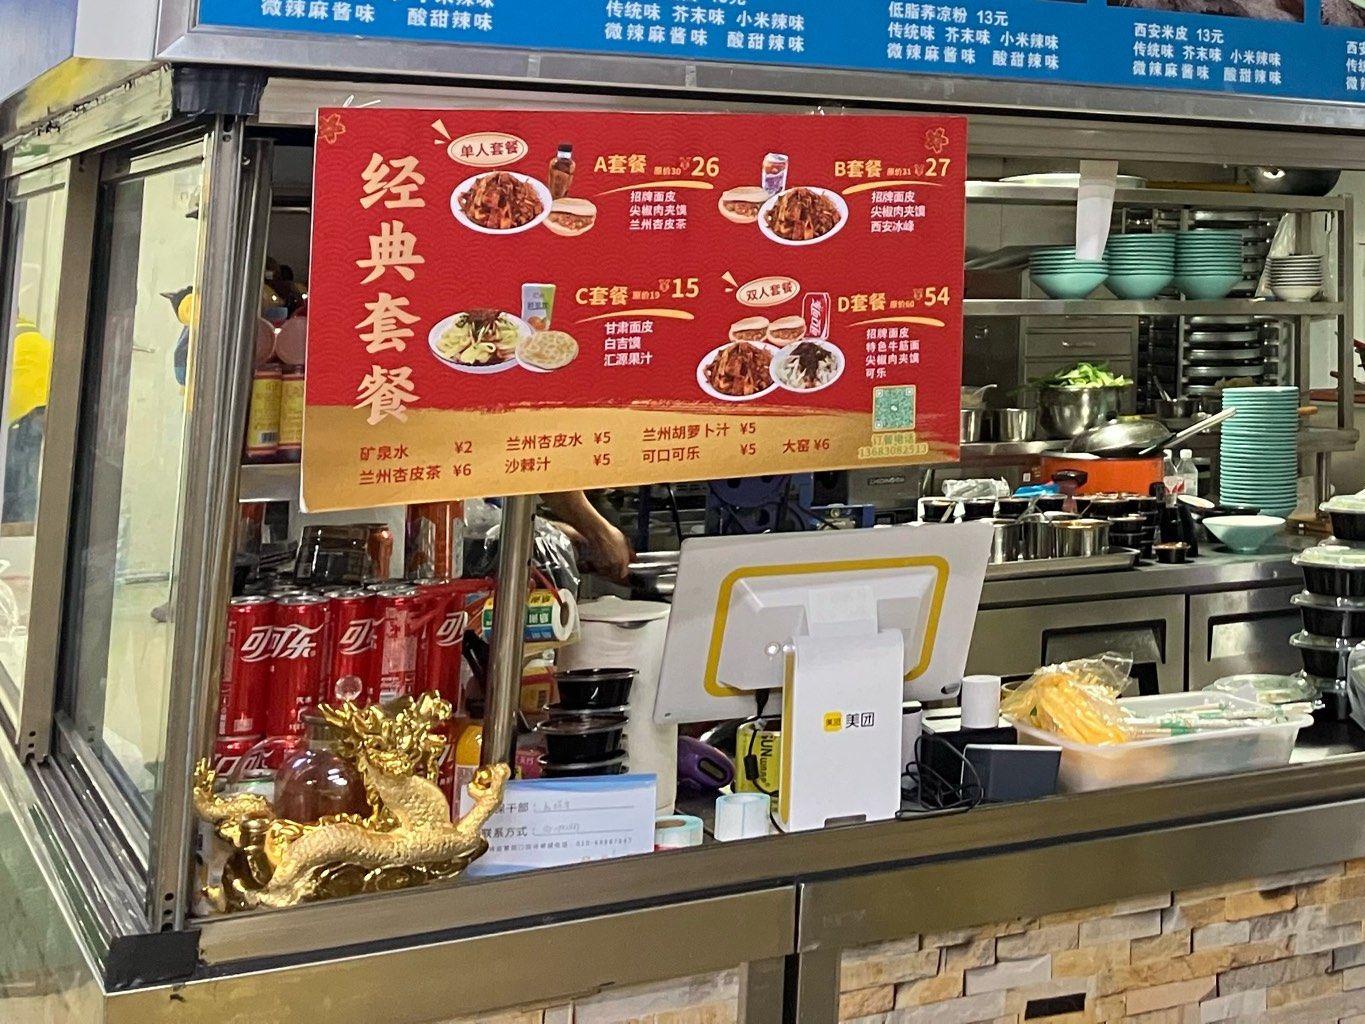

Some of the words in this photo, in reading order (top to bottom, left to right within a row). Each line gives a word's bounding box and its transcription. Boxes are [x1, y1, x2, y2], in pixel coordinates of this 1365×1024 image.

[407, 7, 493, 31] 酸甜辣味
[606, 0, 661, 20] 传统味
[672, 5, 725, 25] 芥末味
[736, 11, 805, 31] 小米辣味
[889, 1, 967, 23] 低脂荞凉粉
[977, 10, 1009, 26] 13元
[605, 23, 708, 46] 微辣麻酱味
[727, 31, 805, 53] 酸甜辣味
[888, 22, 935, 41] 传统味
[945, 27, 991, 45] 芥末味
[1000, 31, 1059, 50] 小米辣味
[1134, 22, 1188, 41] 西安米皮
[1196, 28, 1224, 43] 13元
[887, 43, 976, 64] 微辣麻酱味
[993, 50, 1059, 70] 酸甜辣味
[1133, 41, 1174, 58] 传统味
[1183, 45, 1222, 62] 芥末味
[1230, 49, 1281, 66] 小米辣味
[1133, 60, 1210, 80] 微辣麻酱味
[1224, 67, 1281, 85] 酸甜辣味
[460, 140, 519, 158] 单人套餐
[594, 154, 647, 173] A套餐
[834, 159, 882, 177] B套餐
[630, 191, 676, 202] 招牌面皮
[872, 191, 915, 203] 招牌面皮
[629, 204, 687, 216] 尖椒肉夹馍
[871, 205, 925, 217] 尖椒肉夹馍
[629, 219, 686, 230] 兰州杏皮茶
[870, 220, 914, 232] 西安冰峰
[353, 152, 426, 425] 经典套餐
[575, 286, 628, 306] C套餐
[746, 282, 793, 301] 双人套餐
[837, 292, 886, 313] D套餐
[604, 320, 653, 335] 甘肃面皮
[866, 327, 909, 339] 招牌面皮
[604, 337, 641, 350] 白吉馍
[866, 340, 920, 353] 特色牛筋面
[603, 352, 653, 367] 汇源果汁
[865, 353, 920, 366] 尖椒肉夹馍
[865, 368, 887, 379] 可乐
[505, 432, 582, 452] 兰州杏皮水
[594, 431, 611, 444] ¥5
[642, 422, 730, 442] 兰州胡萝卜汁
[740, 422, 756, 435] ¥5
[359, 445, 409, 461] 矿泉水
[454, 440, 472, 454] ¥2
[642, 446, 700, 463] 可口可乐
[740, 443, 756, 456] ¥5
[782, 439, 810, 454] 大窑
[814, 438, 830, 450] ¥6
[504, 456, 550, 474] 沙棘汁
[593, 453, 611, 466] ¥5
[358, 465, 441, 485] 兰州杏皮茶
[453, 463, 471, 477] ¥6
[845, 712, 874, 728] 美团
